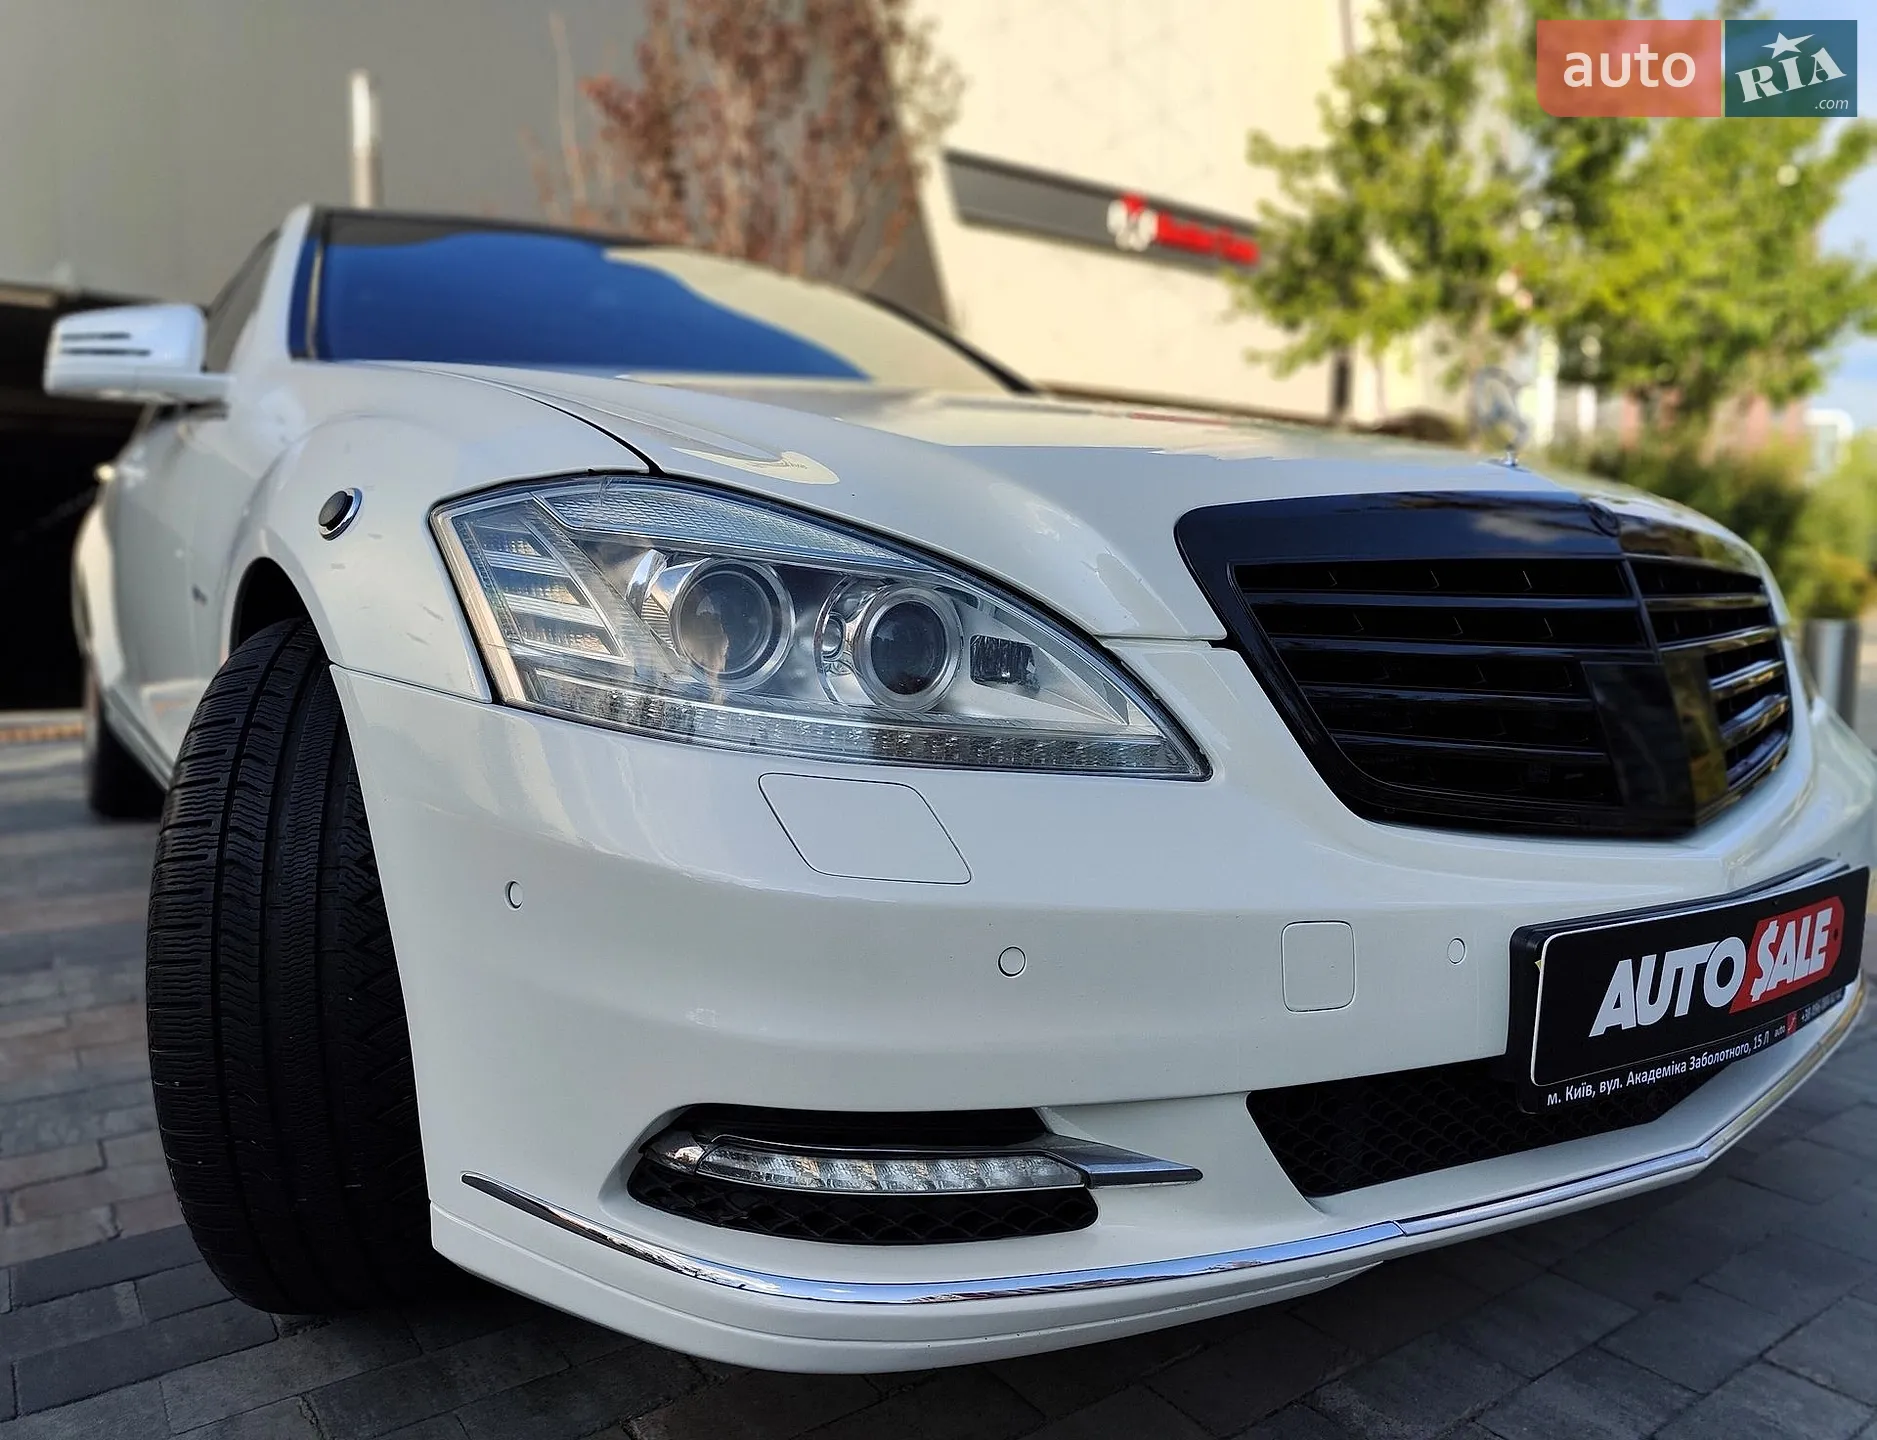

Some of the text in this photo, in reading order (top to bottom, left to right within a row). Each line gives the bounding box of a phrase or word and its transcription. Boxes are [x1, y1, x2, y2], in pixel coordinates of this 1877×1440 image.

[1589, 936, 1747, 1037] AUTO
[1547, 1093, 1561, 1106] м.
[1565, 1082, 1596, 1102] Київ,
[1599, 1080, 1623, 1095] вул.
[1626, 1061, 1687, 1087] Академіка
[1689, 1042, 1752, 1071] Заболотного,
[1753, 1034, 1763, 1050] 15
